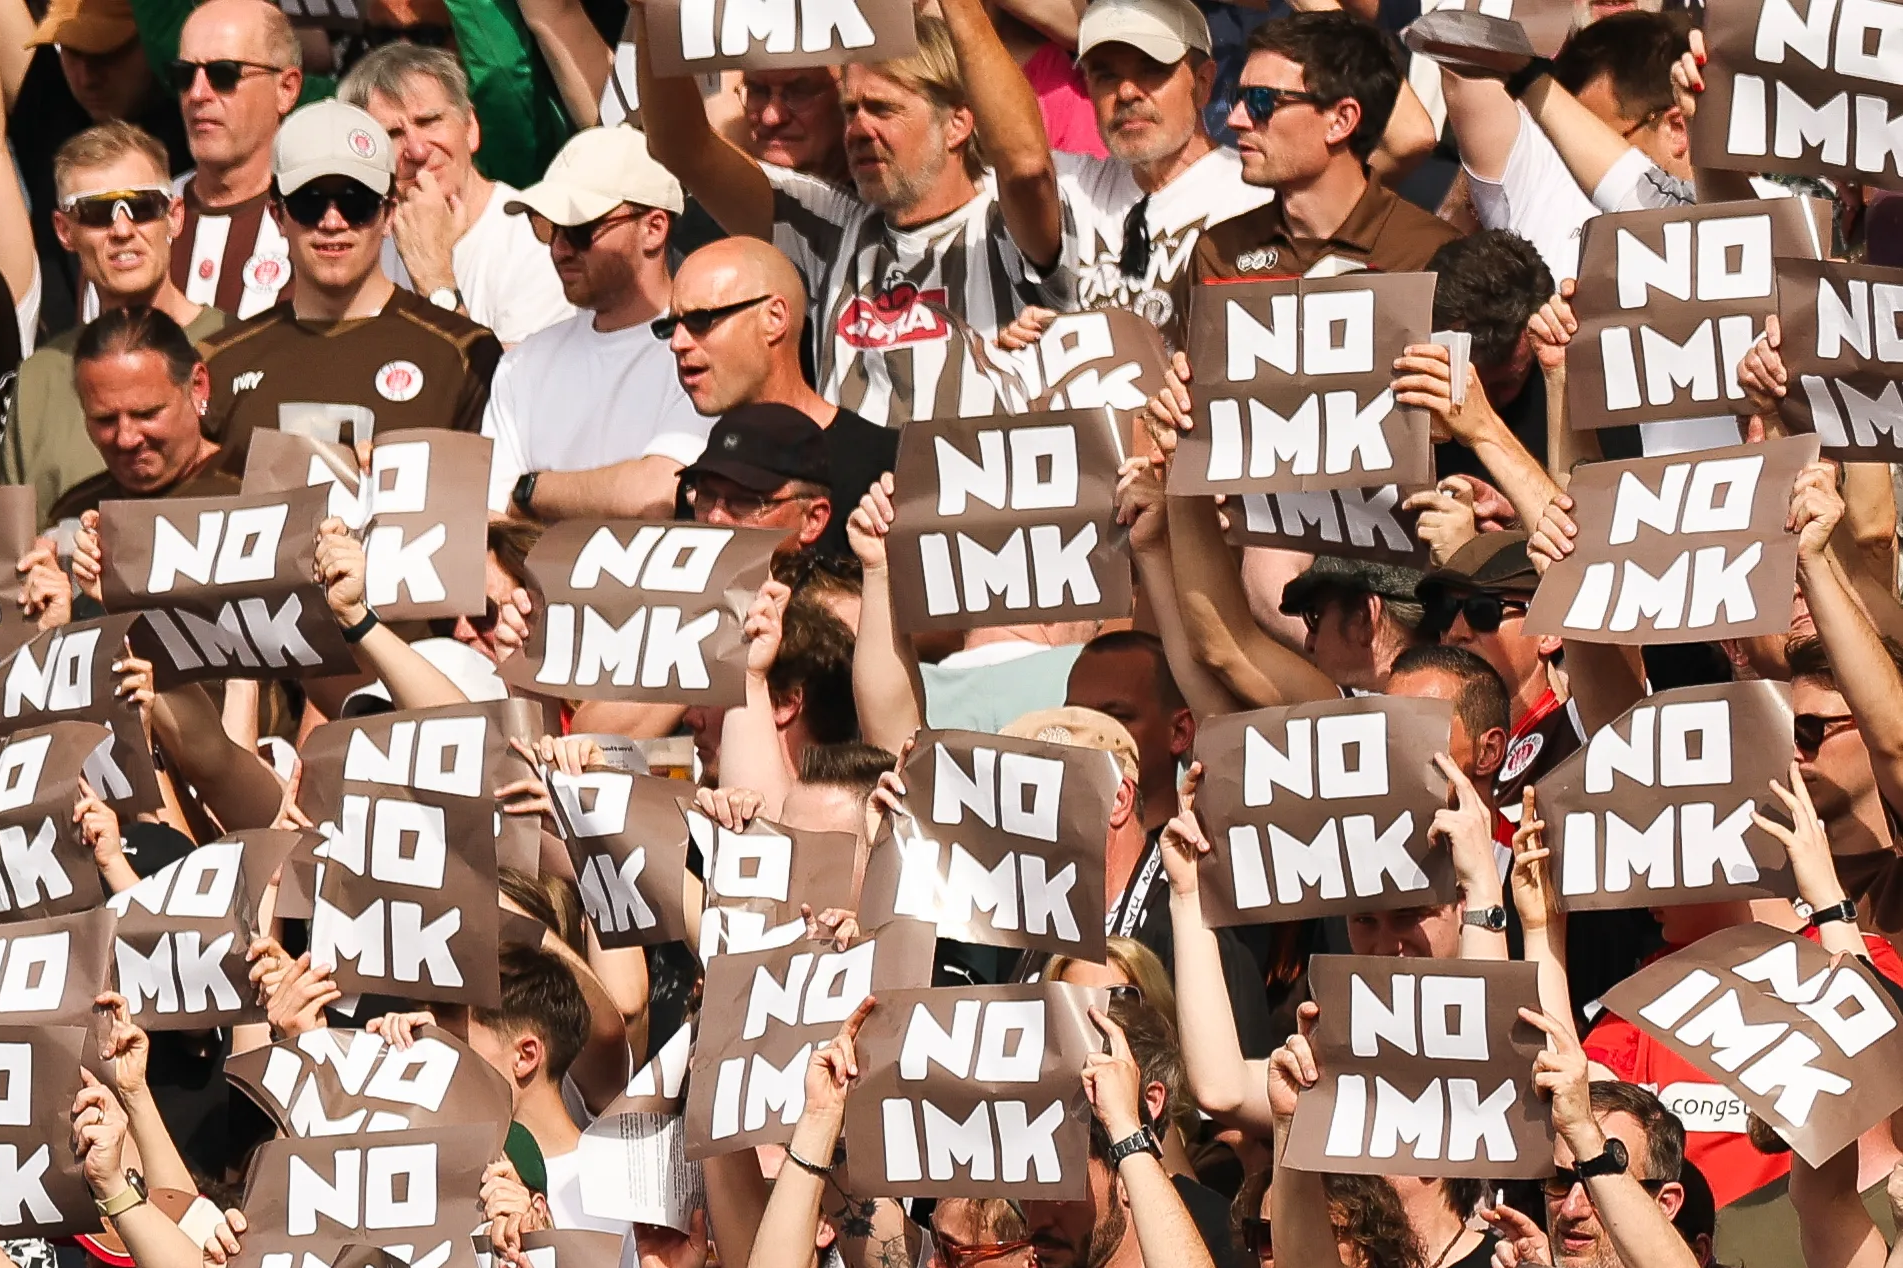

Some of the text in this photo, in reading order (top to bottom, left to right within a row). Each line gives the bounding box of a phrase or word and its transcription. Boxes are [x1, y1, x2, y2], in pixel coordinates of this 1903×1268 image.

[679, 0, 876, 61] IMK
[1754, 0, 1903, 84] NO
[1616, 214, 1772, 309] NO
[1226, 289, 1374, 381] NO
[934, 426, 1079, 517] NO
[1207, 391, 1394, 482] IMK
[1608, 455, 1764, 546] NO
[147, 503, 289, 594] NO
[570, 526, 736, 592] NO
[919, 522, 1101, 617] IMK
[1562, 544, 1762, 631] IMK
[3, 628, 101, 719] NO
[140, 592, 323, 670] IMK
[535, 601, 720, 689] IMK
[345, 716, 487, 799] NO
[932, 742, 1065, 842] NO
[1244, 711, 1389, 808] NO
[1584, 699, 1732, 794] NO
[106, 842, 243, 919] NO
[328, 795, 447, 889] NO
[895, 832, 1080, 942] IMK
[1229, 809, 1430, 909] IMK
[1562, 799, 1759, 897] IMK
[743, 941, 876, 1041] NO
[1351, 973, 1489, 1061] NO
[1731, 941, 1897, 1058] NO
[901, 1000, 1046, 1083] NO
[1639, 968, 1853, 1128] IMK
[884, 1098, 1065, 1183] IMK
[1325, 1074, 1517, 1161] IMK
[288, 1142, 437, 1234] NO
